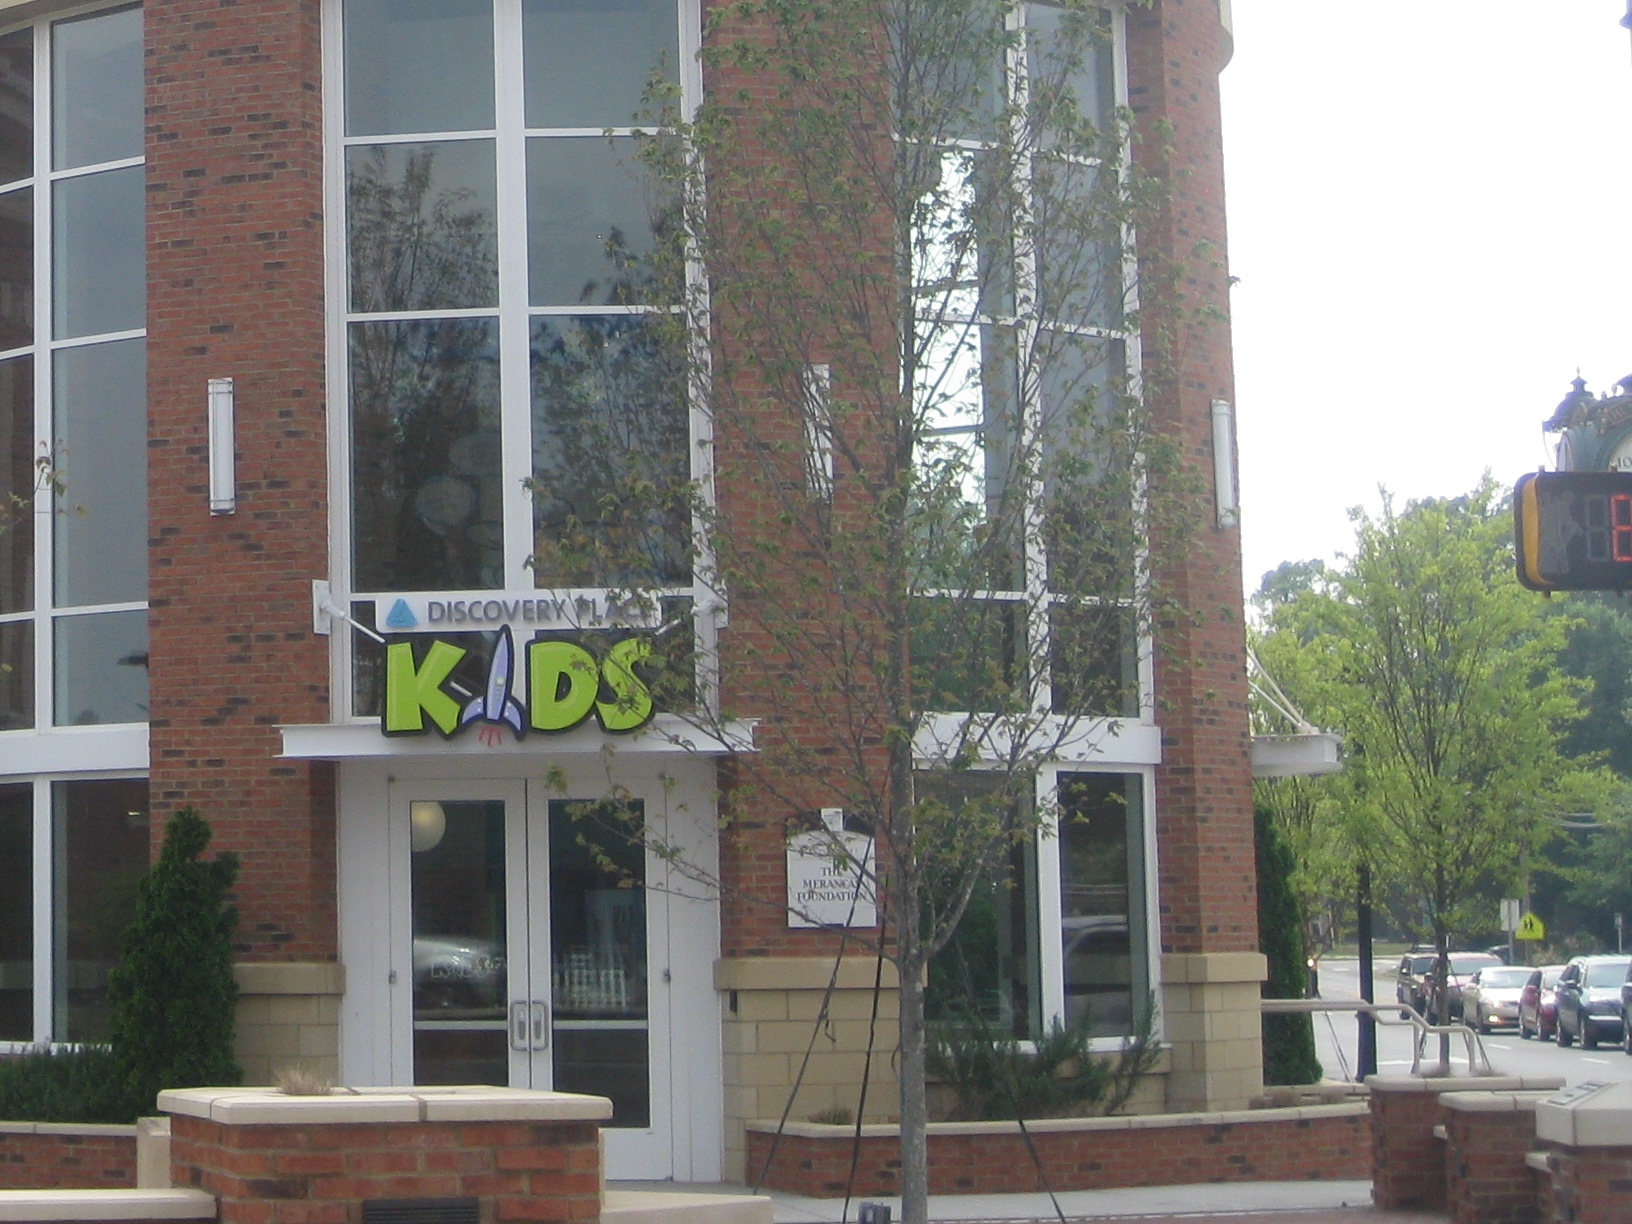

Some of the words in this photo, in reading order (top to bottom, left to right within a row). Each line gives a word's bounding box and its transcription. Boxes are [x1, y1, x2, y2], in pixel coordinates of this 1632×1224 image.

[427, 599, 566, 623] DISCOVERY
[384, 625, 655, 741] KIDS
[803, 879, 860, 889] MERANCA
